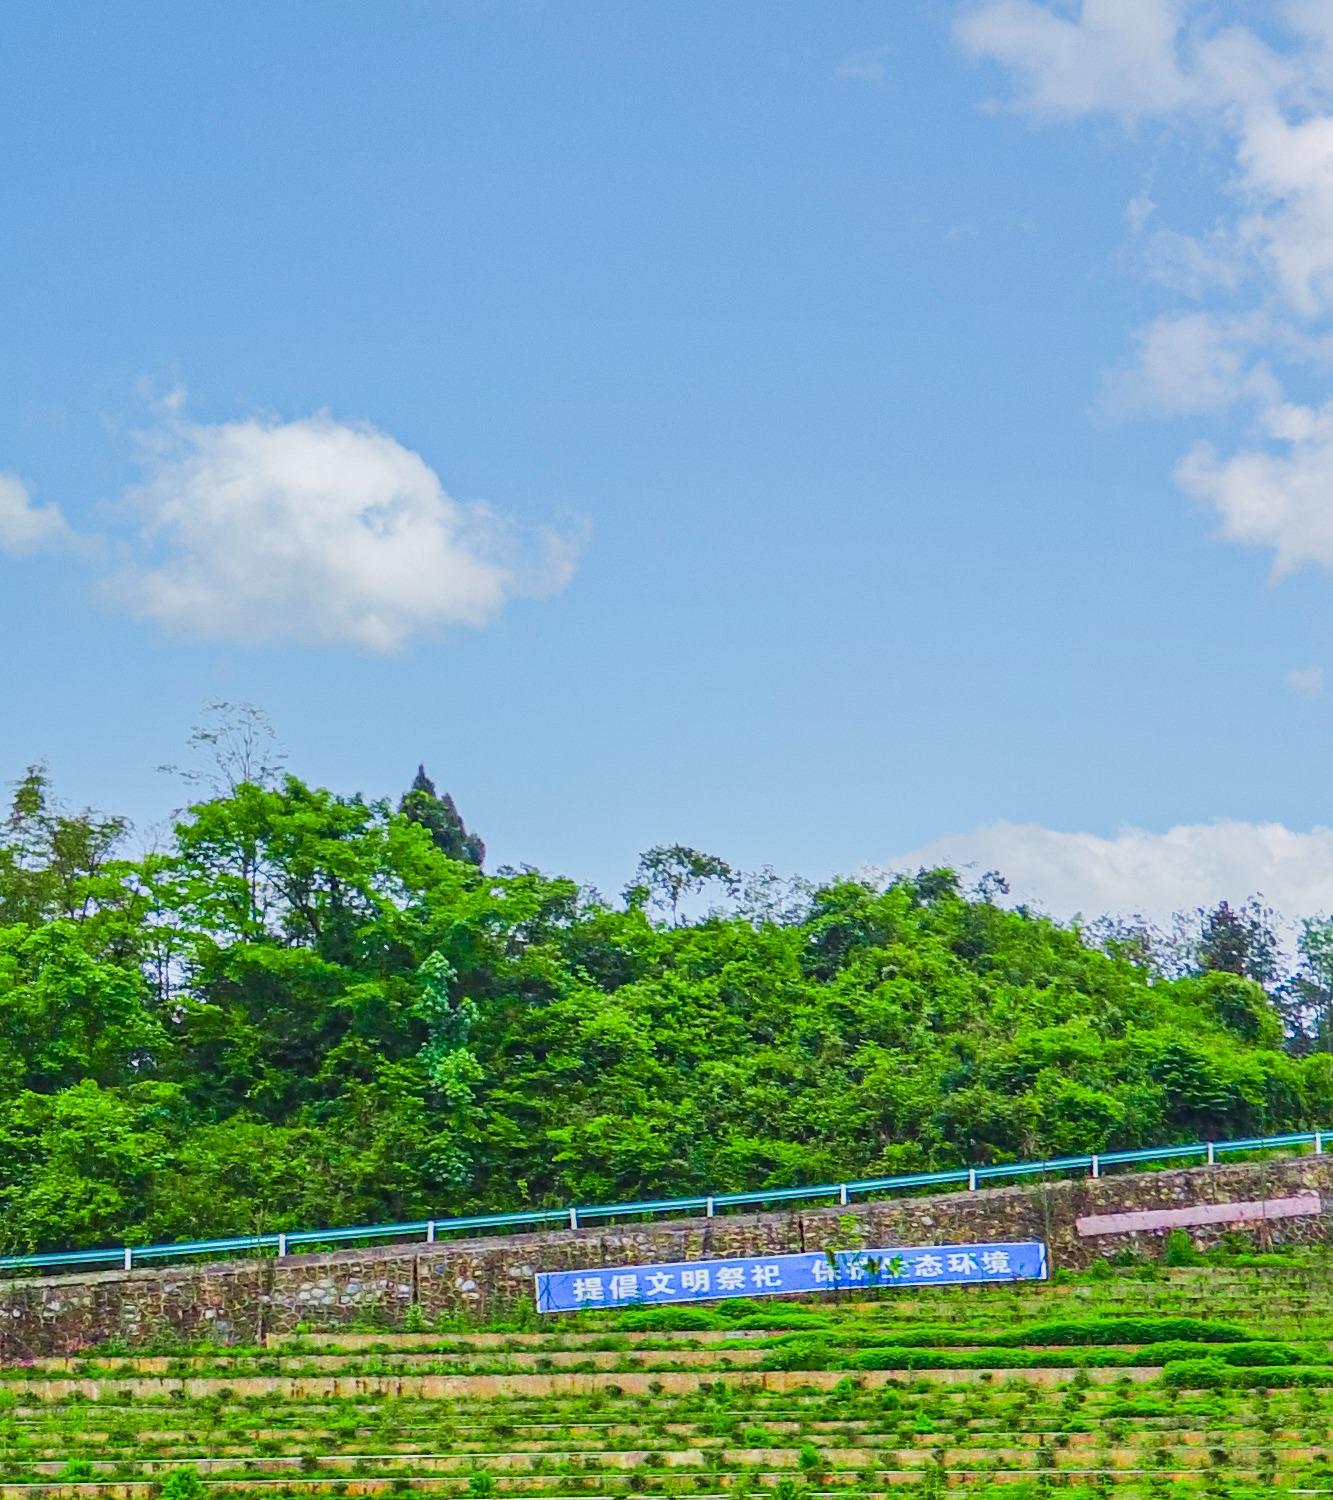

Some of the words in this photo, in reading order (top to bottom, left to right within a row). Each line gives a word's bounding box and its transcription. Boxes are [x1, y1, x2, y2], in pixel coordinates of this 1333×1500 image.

[573, 1264, 782, 1302] 提倡文明祭祀
